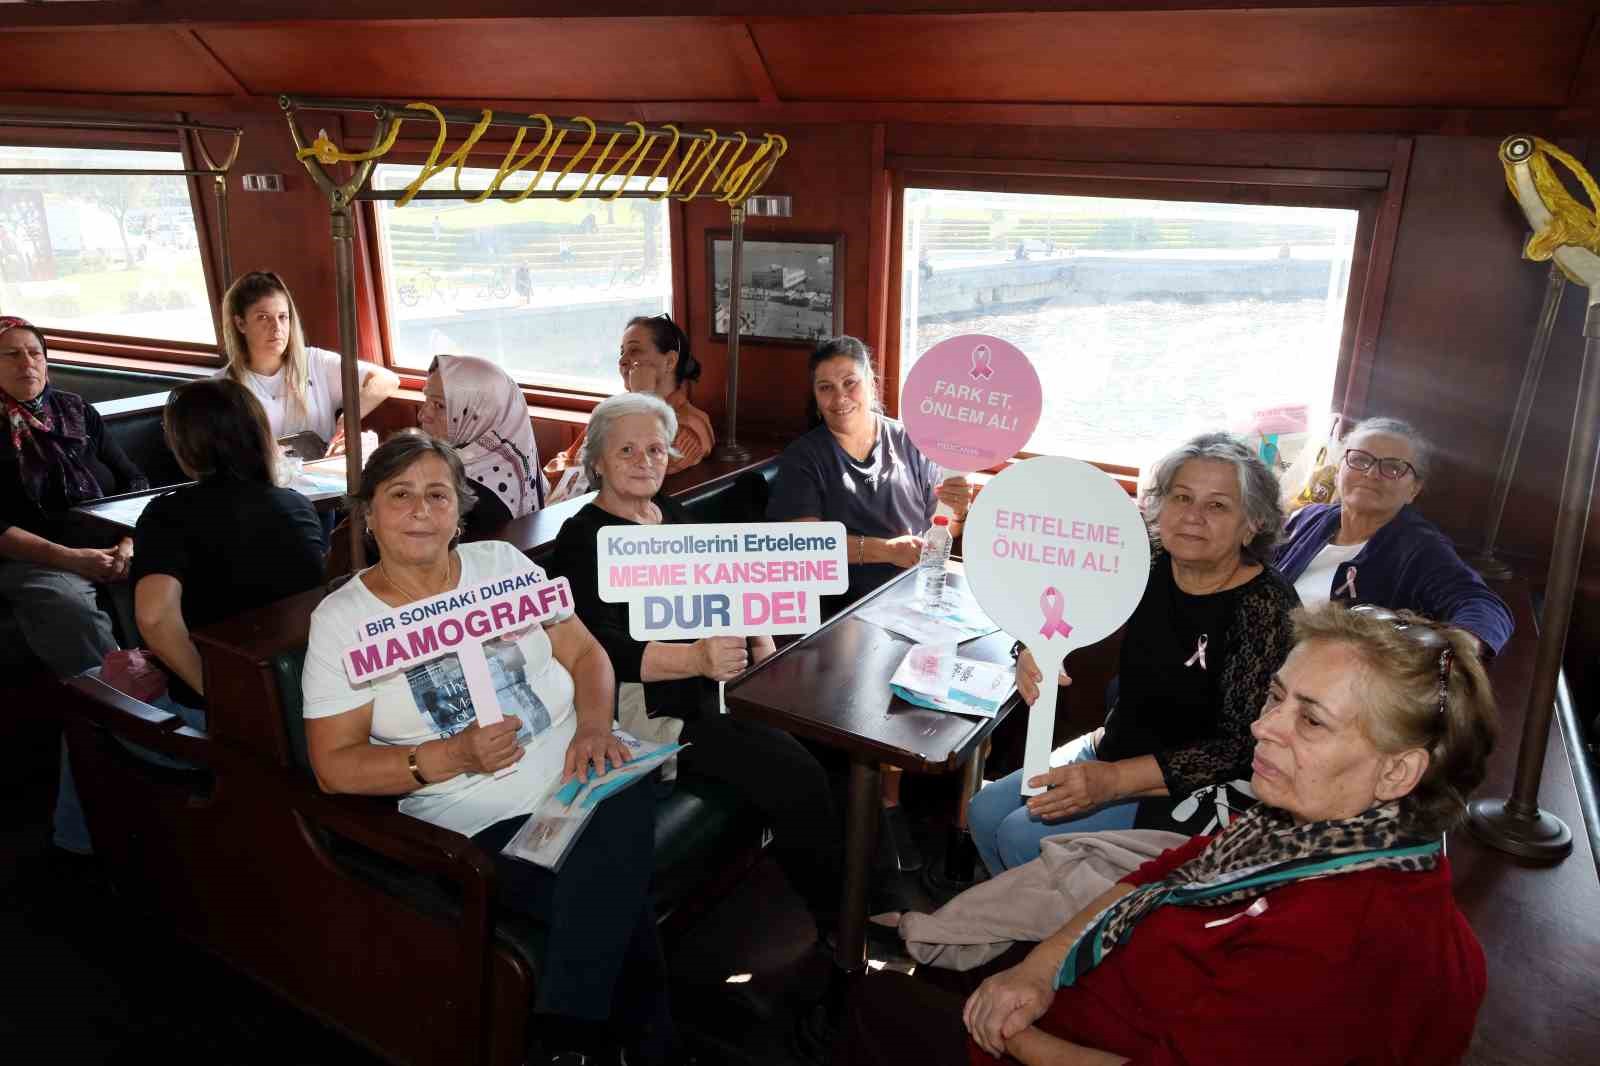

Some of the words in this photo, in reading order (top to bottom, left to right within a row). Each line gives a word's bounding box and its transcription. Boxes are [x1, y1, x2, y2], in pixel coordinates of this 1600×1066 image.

[933, 380, 982, 403] FARK
[919, 397, 985, 425] ÖNLEM
[986, 413, 1019, 431] AL!
[607, 534, 738, 556] Kontrollerini
[744, 533, 838, 552] Erteleme
[995, 509, 1125, 549] ERTELEME,
[992, 535, 1076, 568] ÖNLEM
[1082, 551, 1120, 574] AL!
[480, 571, 542, 600] DURAK:
[609, 563, 688, 588] MEME
[643, 593, 731, 630] DUR
[742, 591, 808, 626] DE!
